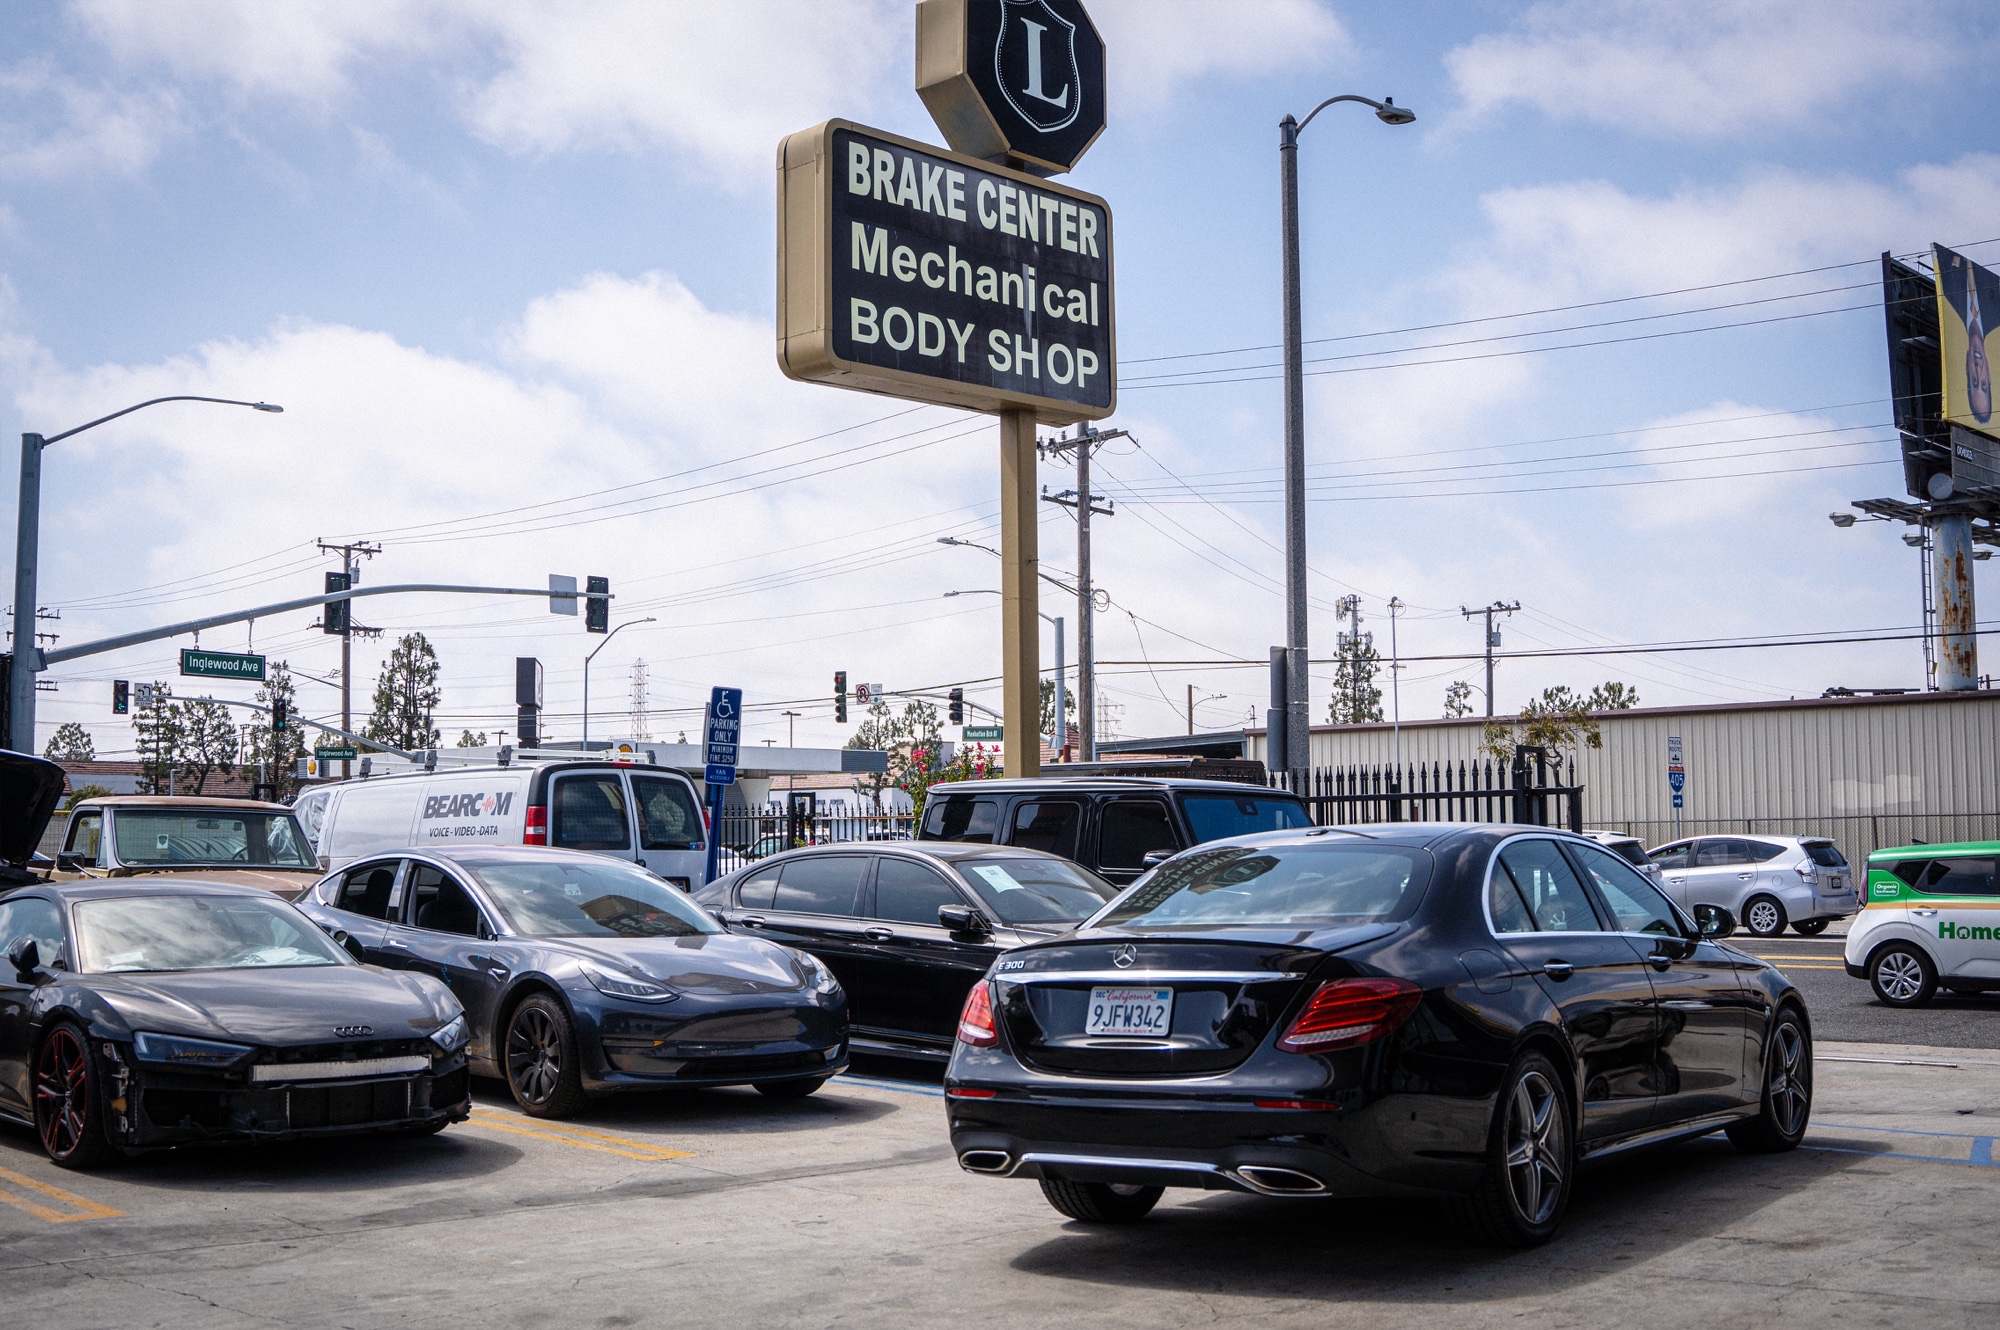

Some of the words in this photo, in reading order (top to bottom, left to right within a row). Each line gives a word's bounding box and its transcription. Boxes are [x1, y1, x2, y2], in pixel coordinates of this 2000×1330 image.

[1020, 16, 1069, 109] L
[848, 141, 967, 223] BRAKE
[976, 178, 1100, 259] CENTER
[851, 221, 1099, 327] Mechanical
[850, 297, 975, 363] BODY
[988, 329, 1099, 388] SHOP
[189, 655, 240, 671] Inglewood
[241, 660, 259, 672] Ave
[710, 718, 738, 730] PARKING
[714, 731, 732, 742] ONLY
[318, 750, 344, 758] Inglewood
[712, 745, 734, 754] MINIMUM
[709, 754, 721, 763] FINE
[721, 754, 734, 763] $250
[1670, 774, 1684, 786] 405
[429, 827, 450, 838] VOICE
[454, 825, 476, 837] VIDEO
[1938, 922, 2000, 940] Home
[998, 962, 1005, 970] E
[1005, 960, 1025, 970] 300
[1107, 989, 1157, 1005] California
[1092, 1004, 1165, 1028] 9JFW342
